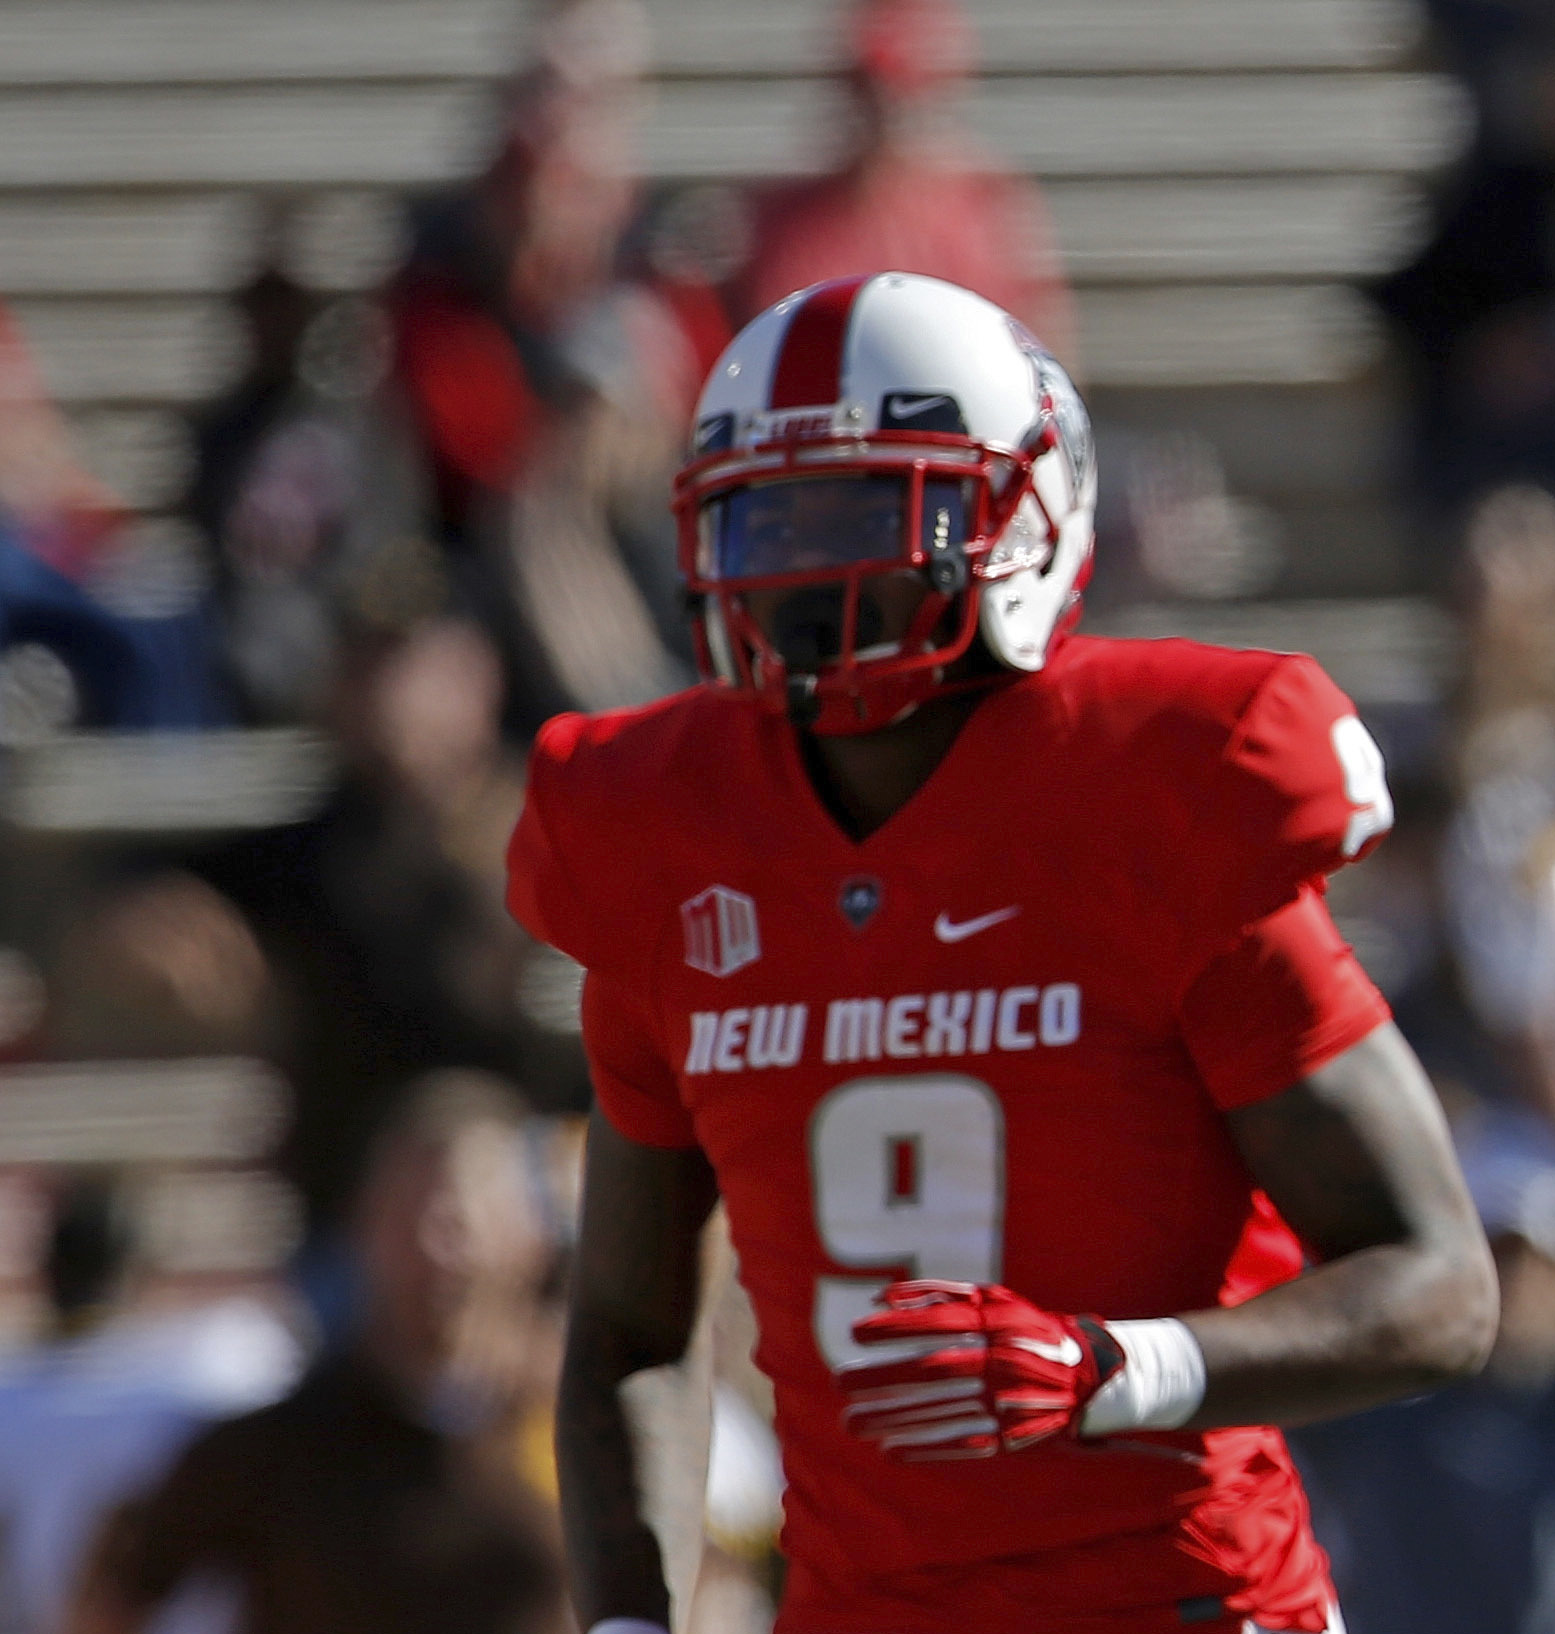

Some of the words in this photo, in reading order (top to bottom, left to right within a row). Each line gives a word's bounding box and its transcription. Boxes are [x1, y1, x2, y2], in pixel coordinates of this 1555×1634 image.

[686, 1004, 808, 1075] NEW
[823, 983, 1082, 1064] MEXICO
[809, 1072, 1007, 1373] 9
